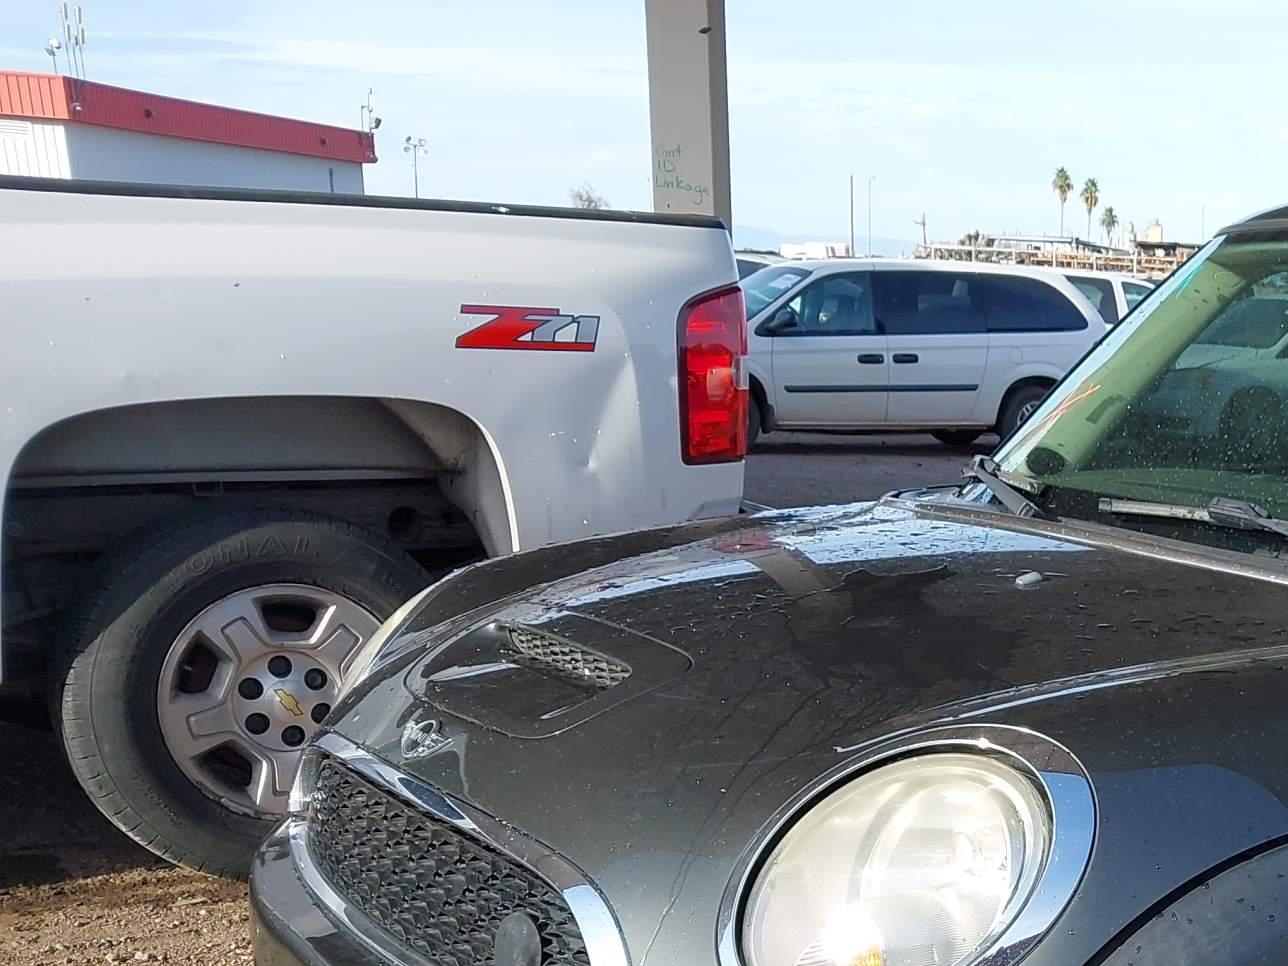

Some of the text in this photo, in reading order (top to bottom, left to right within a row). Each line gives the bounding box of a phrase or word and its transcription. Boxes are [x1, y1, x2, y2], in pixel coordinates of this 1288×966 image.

[657, 159, 676, 173] ID
[655, 175, 711, 205] Linkage
[455, 304, 600, 352] Z71
